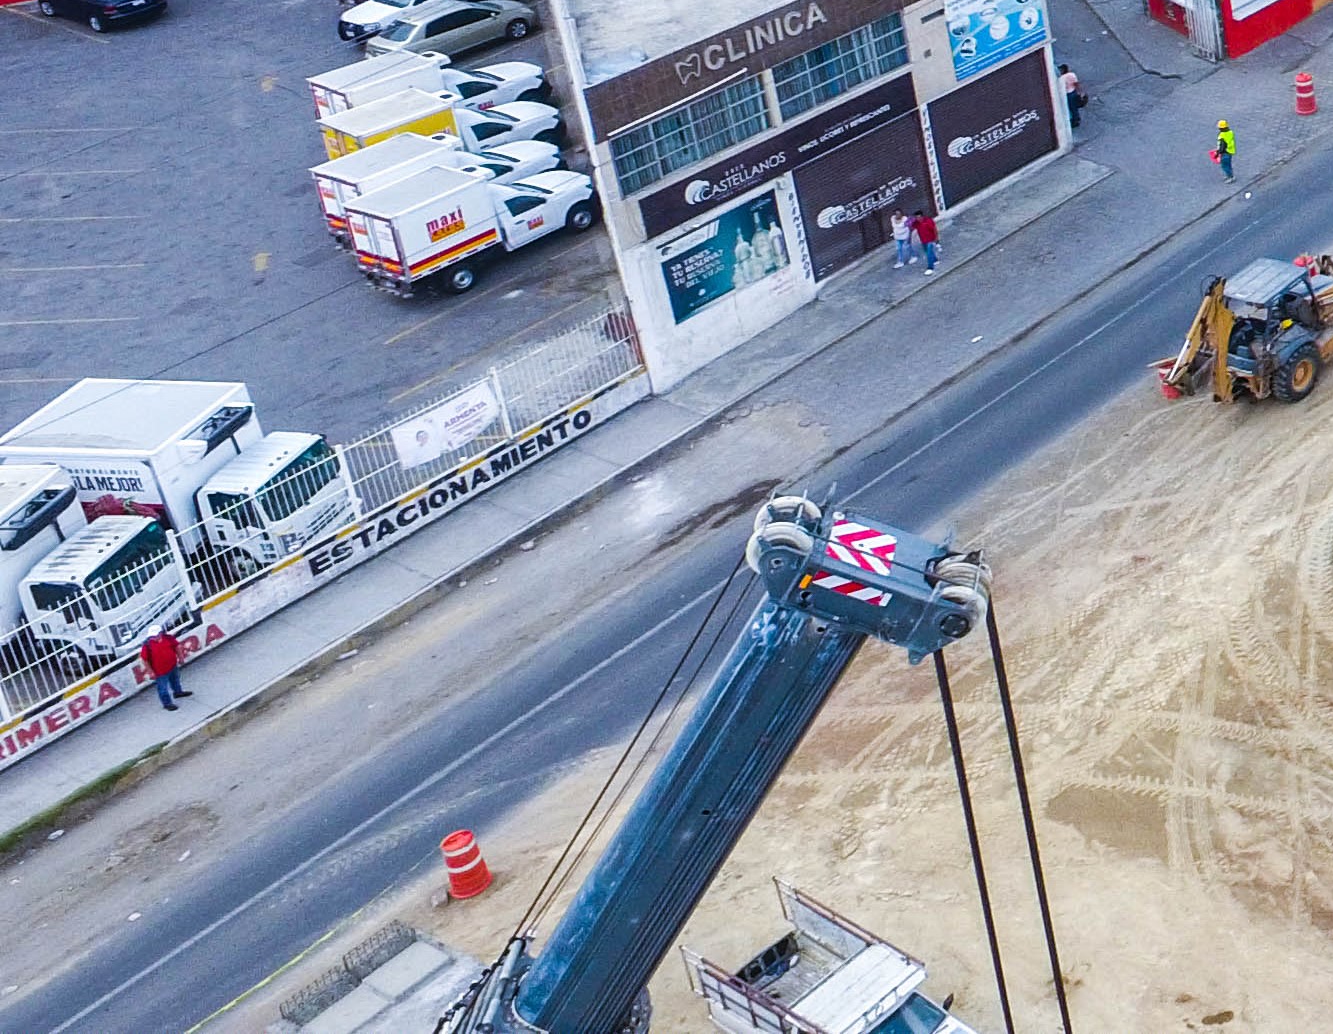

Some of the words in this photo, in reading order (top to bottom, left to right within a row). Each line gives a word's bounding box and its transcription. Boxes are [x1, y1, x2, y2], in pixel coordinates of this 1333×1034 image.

[703, 3, 829, 71] CLINICA
[965, 110, 1037, 153] CASTELLANOS
[701, 151, 786, 200] CASTELLANOS
[426, 205, 463, 233] maxi
[836, 177, 913, 223] CASTELLANOS
[444, 401, 488, 428] ARMENTA
[97, 476, 145, 493] MEJOR!
[308, 410, 593, 577] ESTACIONAMIENTO
[0, 681, 122, 759] IMERA
[132, 623, 226, 685] HRA
